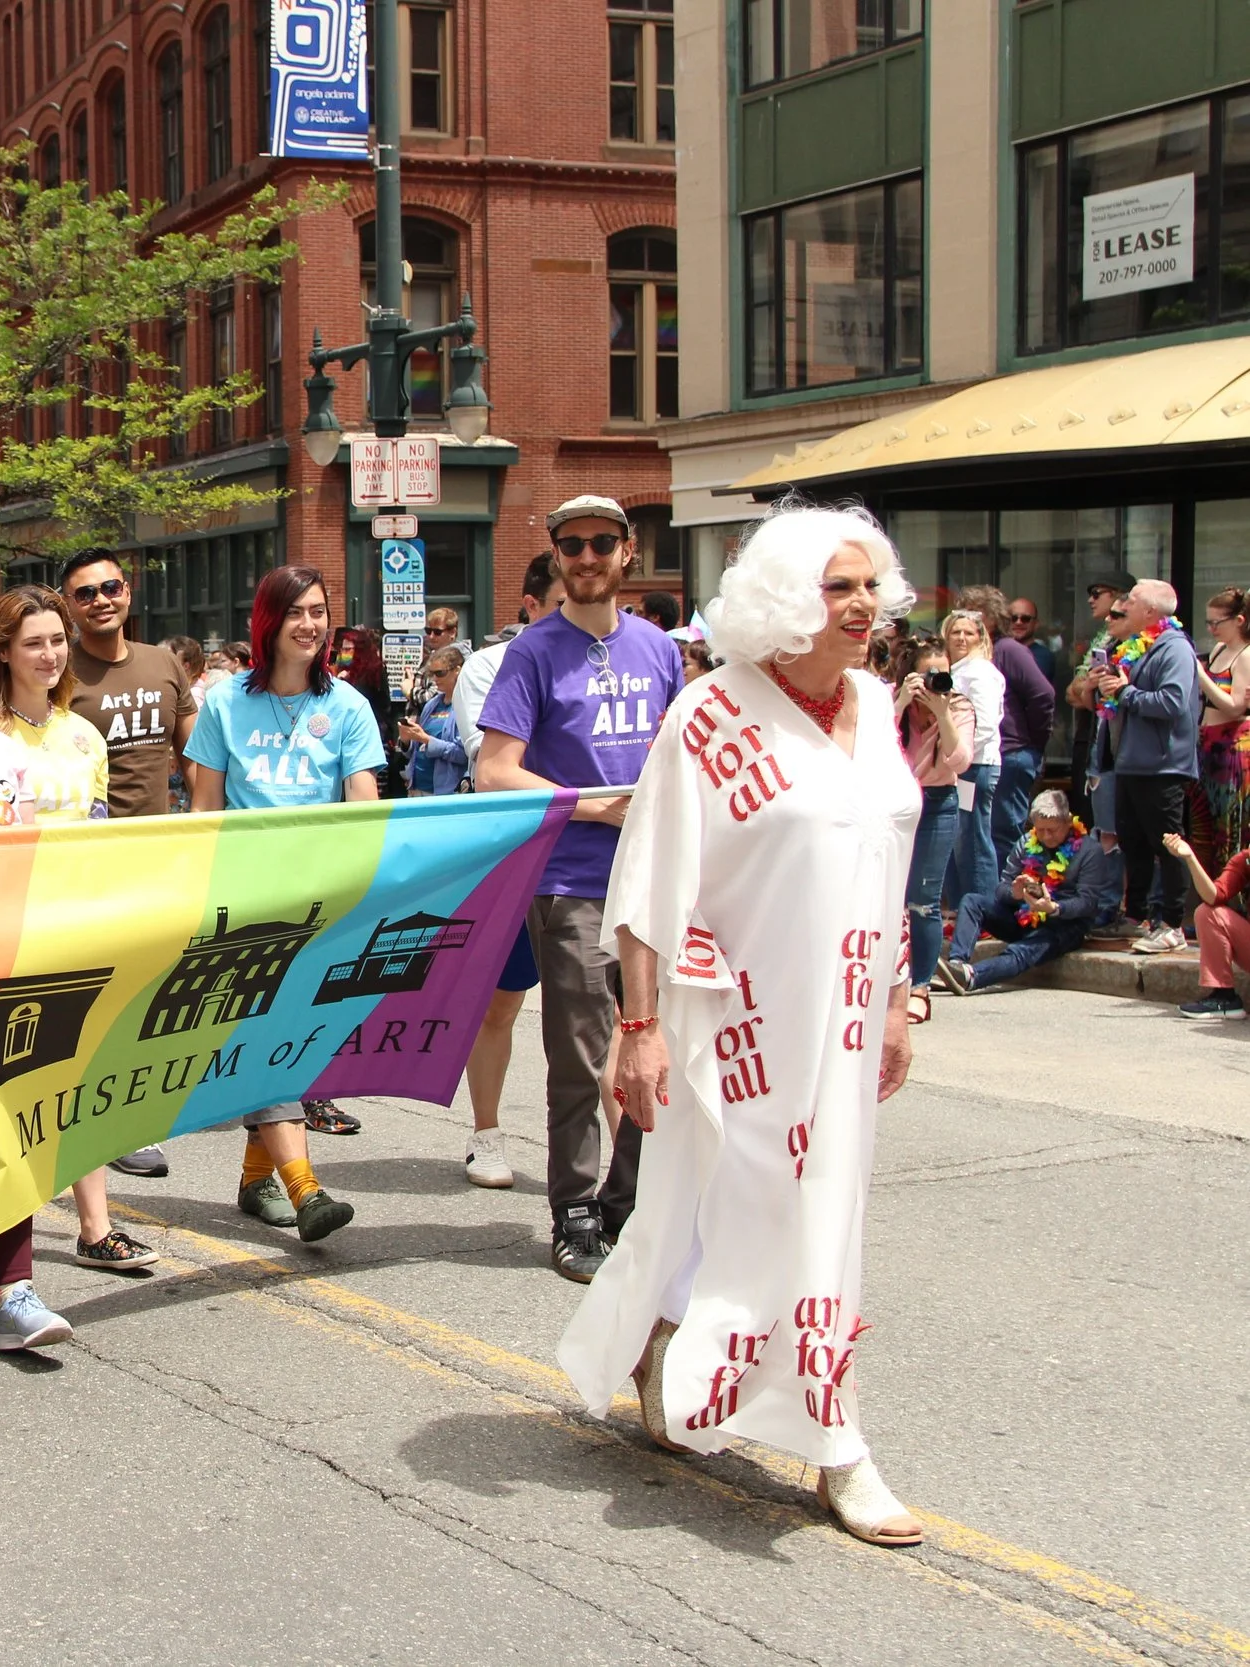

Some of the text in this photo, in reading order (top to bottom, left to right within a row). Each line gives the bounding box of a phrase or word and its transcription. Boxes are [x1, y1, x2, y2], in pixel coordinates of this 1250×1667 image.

[295, 89, 355, 100] angela adams
[310, 109, 344, 117] CREATIVE
[1104, 225, 1182, 259] LEASE
[1099, 257, 1176, 284] 207-797-0000
[365, 445, 381, 457] NO
[409, 444, 425, 456] NO
[355, 460, 392, 473] PARKING
[365, 473, 383, 482] ANY
[399, 459, 436, 471] PARKING
[410, 472, 426, 481] BUS
[364, 483, 383, 492] TIME
[407, 482, 428, 491] STOP
[621, 672, 651, 697] for
[100, 687, 161, 710] Art for
[105, 708, 165, 741] ALL
[592, 699, 652, 735] ALL
[682, 683, 741, 755] art
[246, 728, 309, 752] Art fo
[245, 753, 316, 785] ALL
[700, 724, 763, 790] for
[729, 753, 793, 822] all
[841, 929, 880, 961] ar
[714, 1015, 763, 1062] or
[16, 1043, 246, 1158] MUSEUM
[268, 1025, 326, 1070] of
[332, 1019, 450, 1057] ART
[721, 1052, 771, 1104] all
